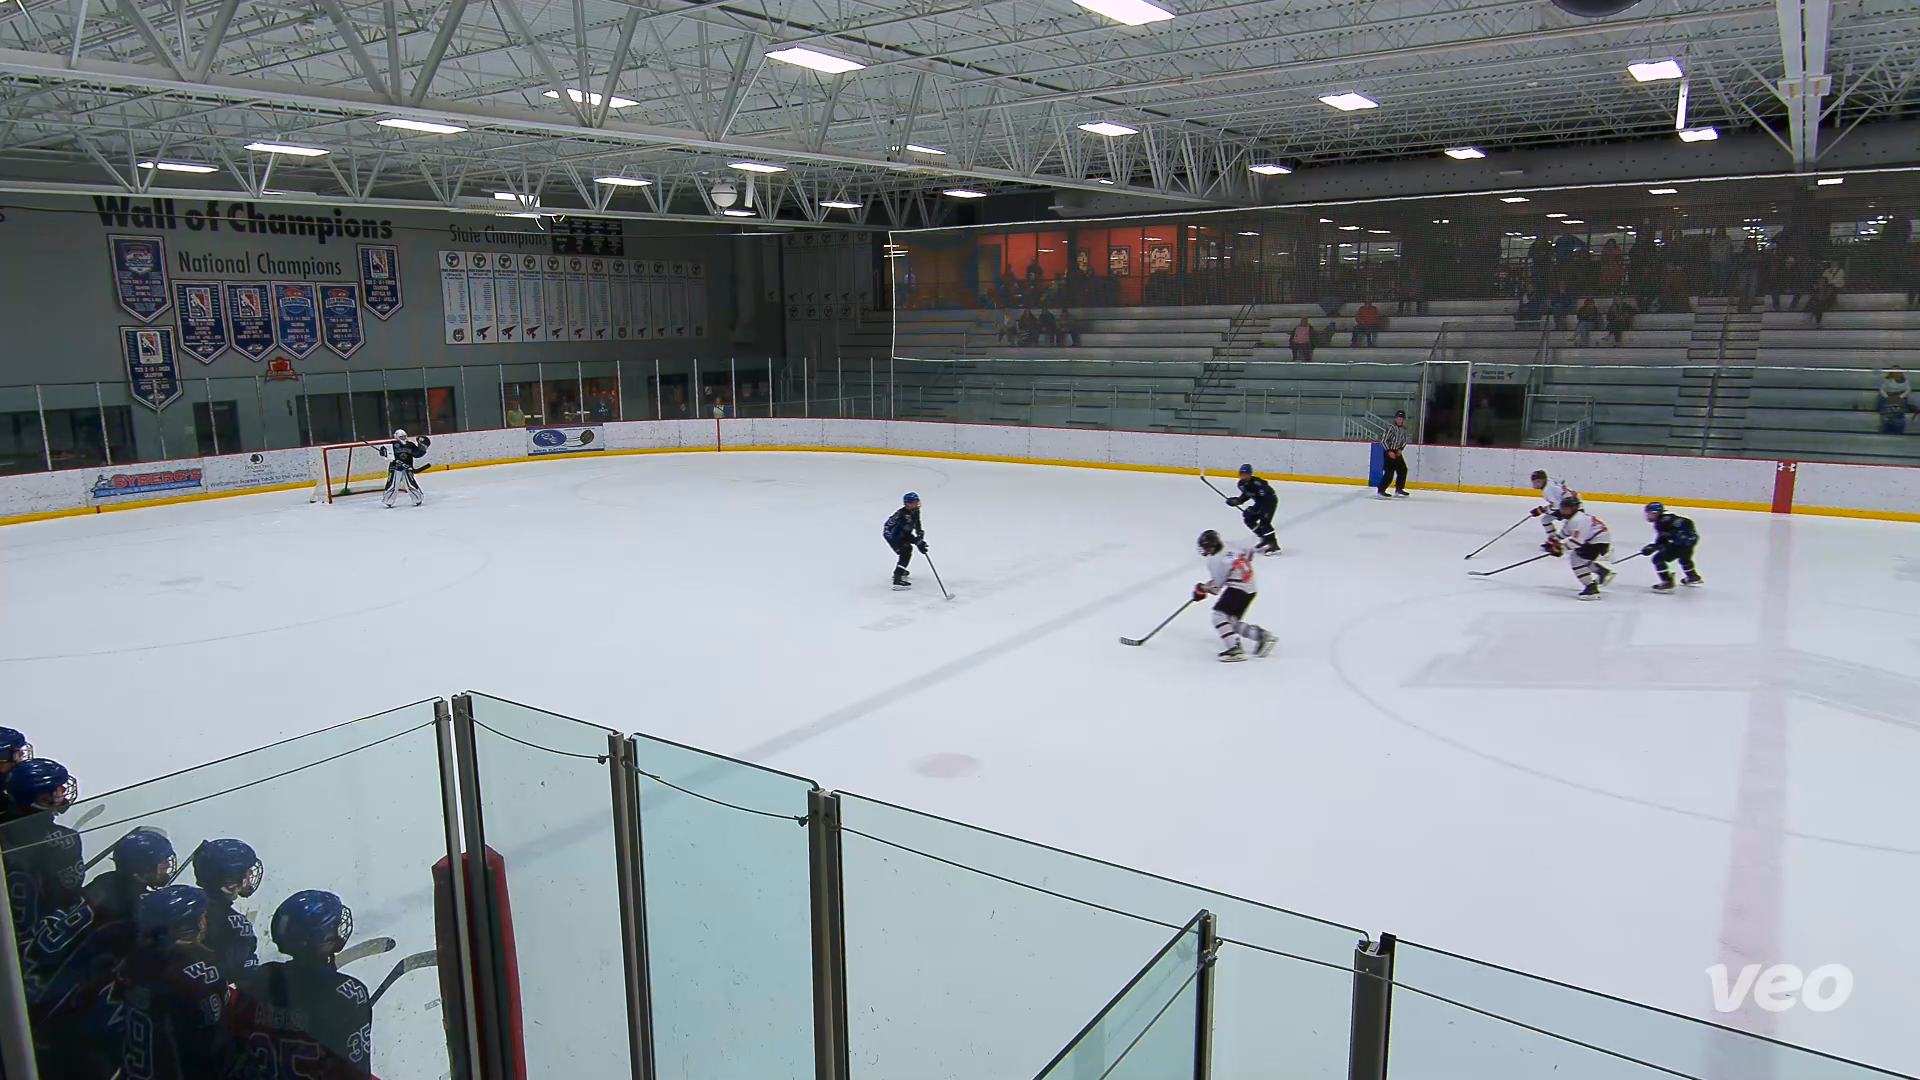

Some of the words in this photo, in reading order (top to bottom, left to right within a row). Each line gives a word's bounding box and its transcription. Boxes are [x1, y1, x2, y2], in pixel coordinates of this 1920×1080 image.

[94, 195, 176, 230] Wall
[184, 199, 219, 232] of
[226, 200, 394, 244] Champions
[484, 225, 548, 249] Champions
[178, 251, 251, 274] National
[257, 252, 342, 280] Champions
[112, 469, 203, 489] SYBERG'S
[183, 960, 220, 984] WD
[336, 978, 368, 1006] WD
[347, 1022, 371, 1063] 35
